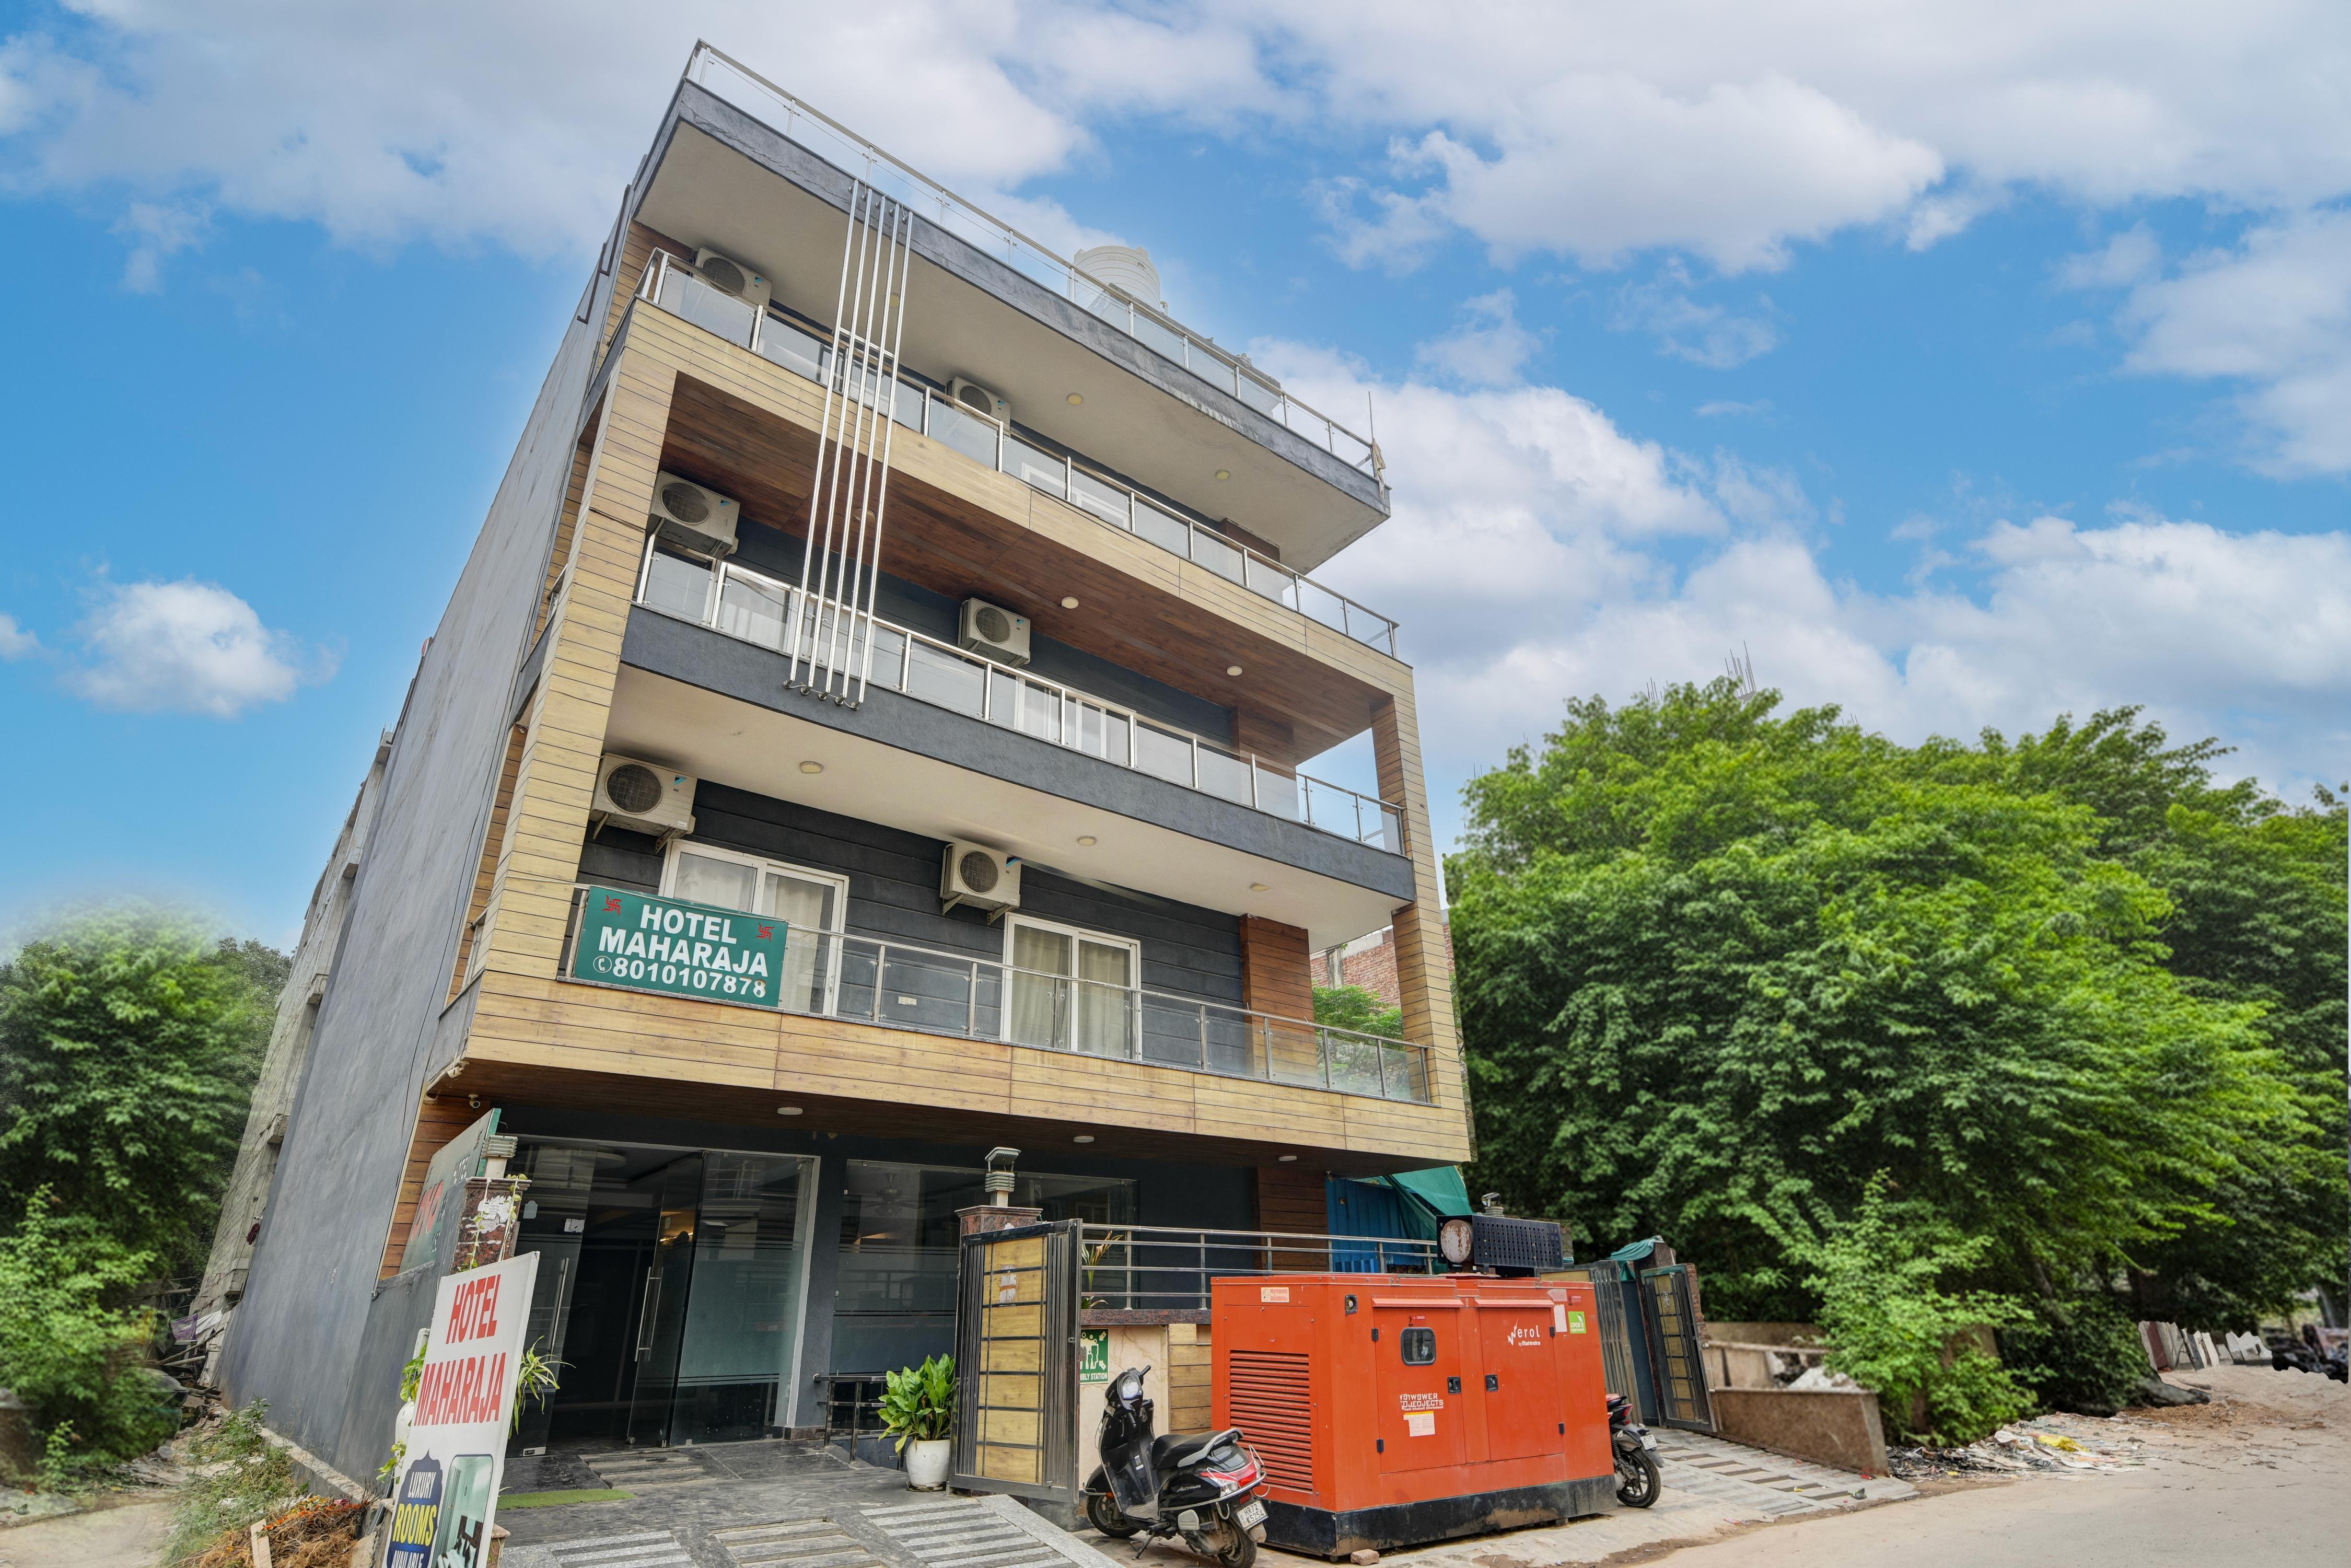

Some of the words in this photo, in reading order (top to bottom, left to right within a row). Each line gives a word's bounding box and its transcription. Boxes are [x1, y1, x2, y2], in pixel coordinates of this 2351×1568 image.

[640, 904, 737, 944] HOTEL
[598, 926, 768, 977] MAHARAJA
[613, 957, 766, 998] 8010107878
[445, 1274, 501, 1344] HOTEL
[413, 1352, 506, 1426] MAHARAJA
[1214, 1437, 1227, 1446] HONDA
[408, 1471, 437, 1499] LUXURY
[392, 1503, 437, 1547] ROOMS
